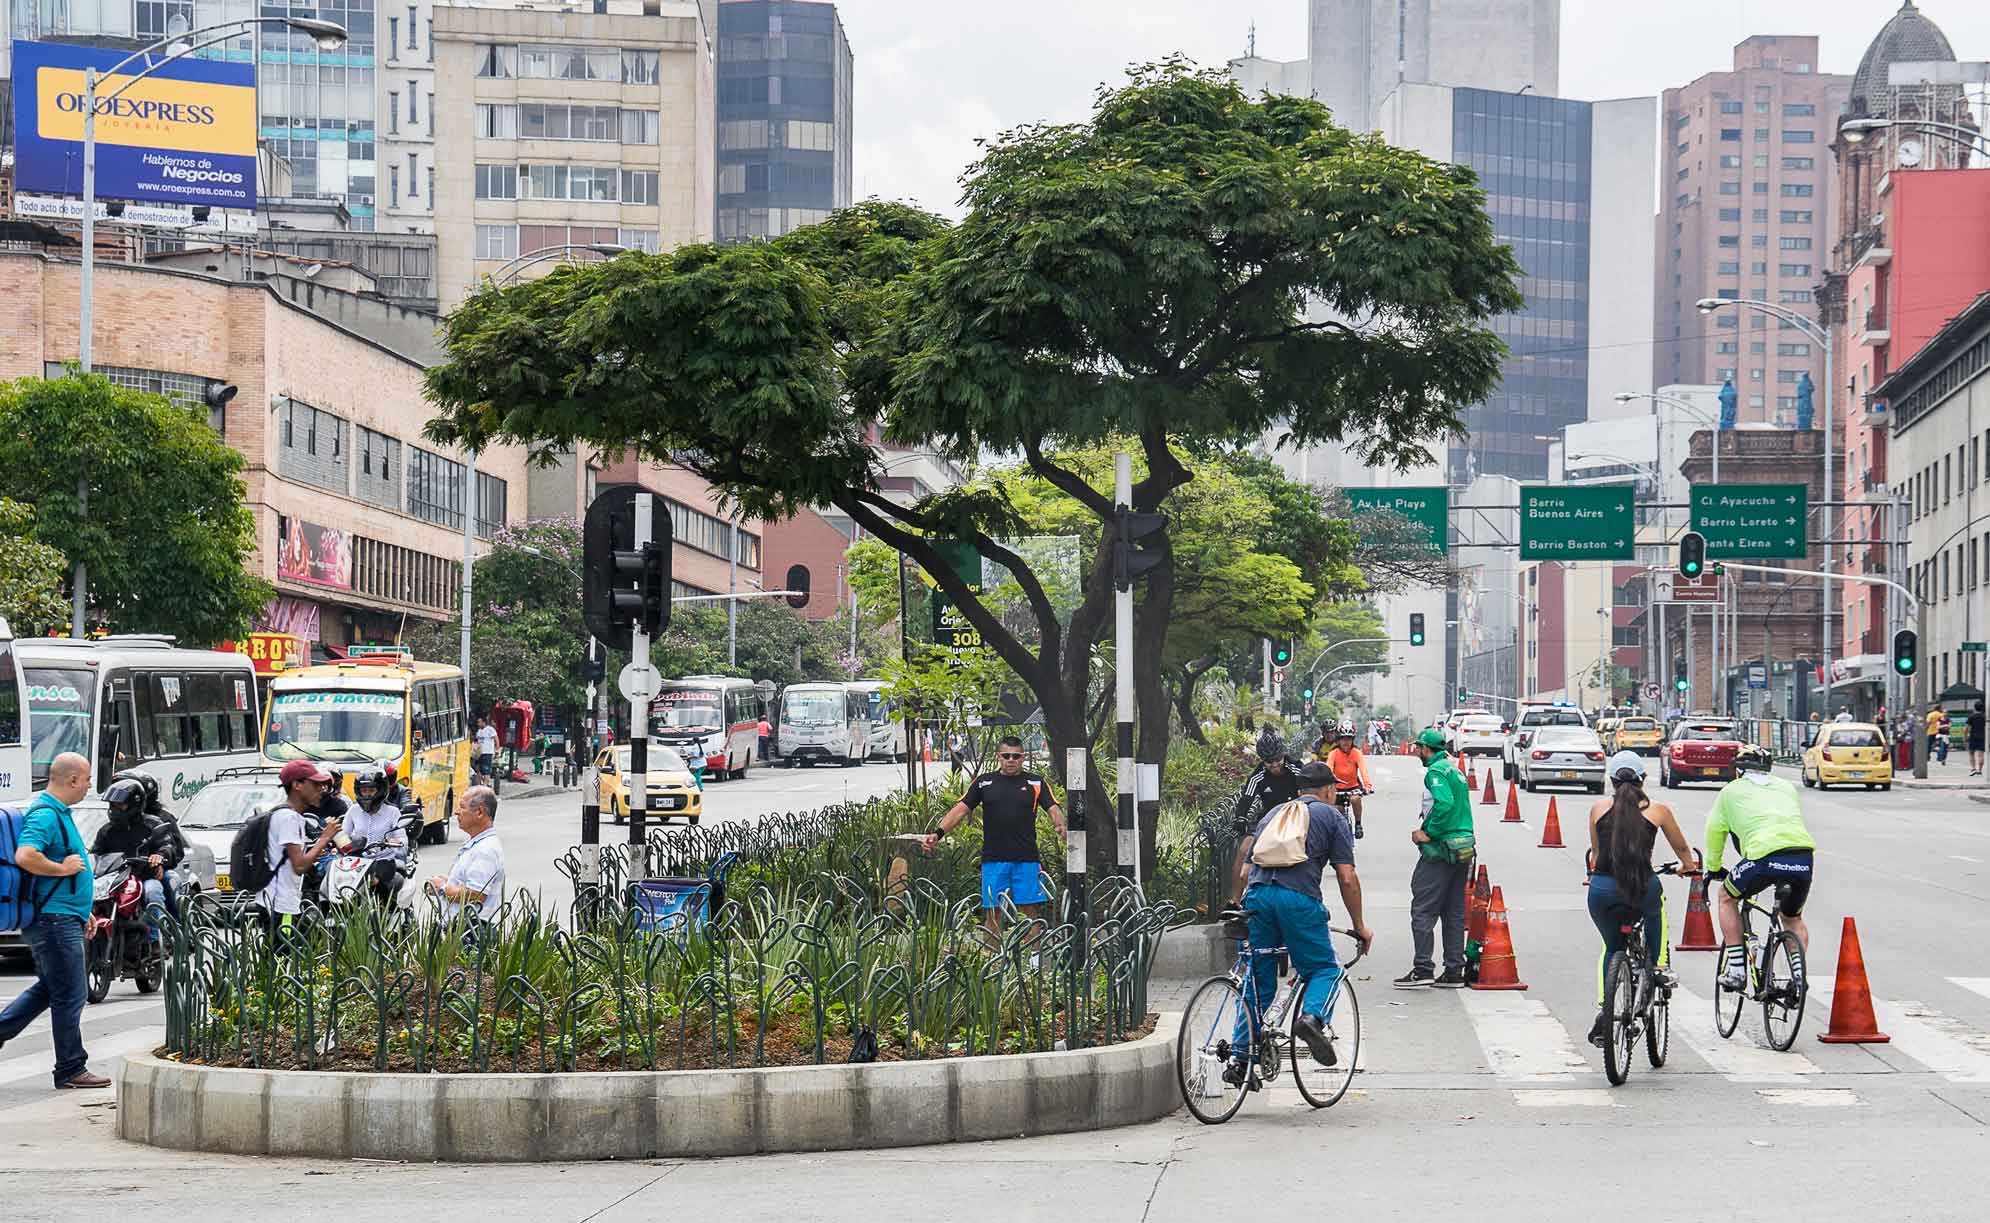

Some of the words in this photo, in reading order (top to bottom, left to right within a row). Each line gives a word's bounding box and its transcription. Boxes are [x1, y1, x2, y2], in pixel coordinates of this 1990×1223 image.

[143, 153, 196, 168] Hablemos
[198, 158, 212, 168] de
[162, 165, 243, 183] Negocios
[137, 182, 246, 198] www.oroexpress.com.co
[20, 200, 38, 211] Todo
[41, 203, 57, 213] acto
[1377, 499, 1391, 508] La
[1395, 499, 1426, 510] Playa
[1529, 498, 1565, 507] Barrio
[1720, 496, 1776, 507] Ayacucho
[1529, 508, 1571, 518] Buenos
[1574, 508, 1604, 518] Aires
[1700, 517, 1736, 526] Barrio
[1740, 517, 1778, 526] Loreto
[1529, 539, 1564, 549] Barrio
[1567, 539, 1607, 549] Boston
[1739, 538, 1772, 548] Elena
[952, 632, 981, 646] 308
